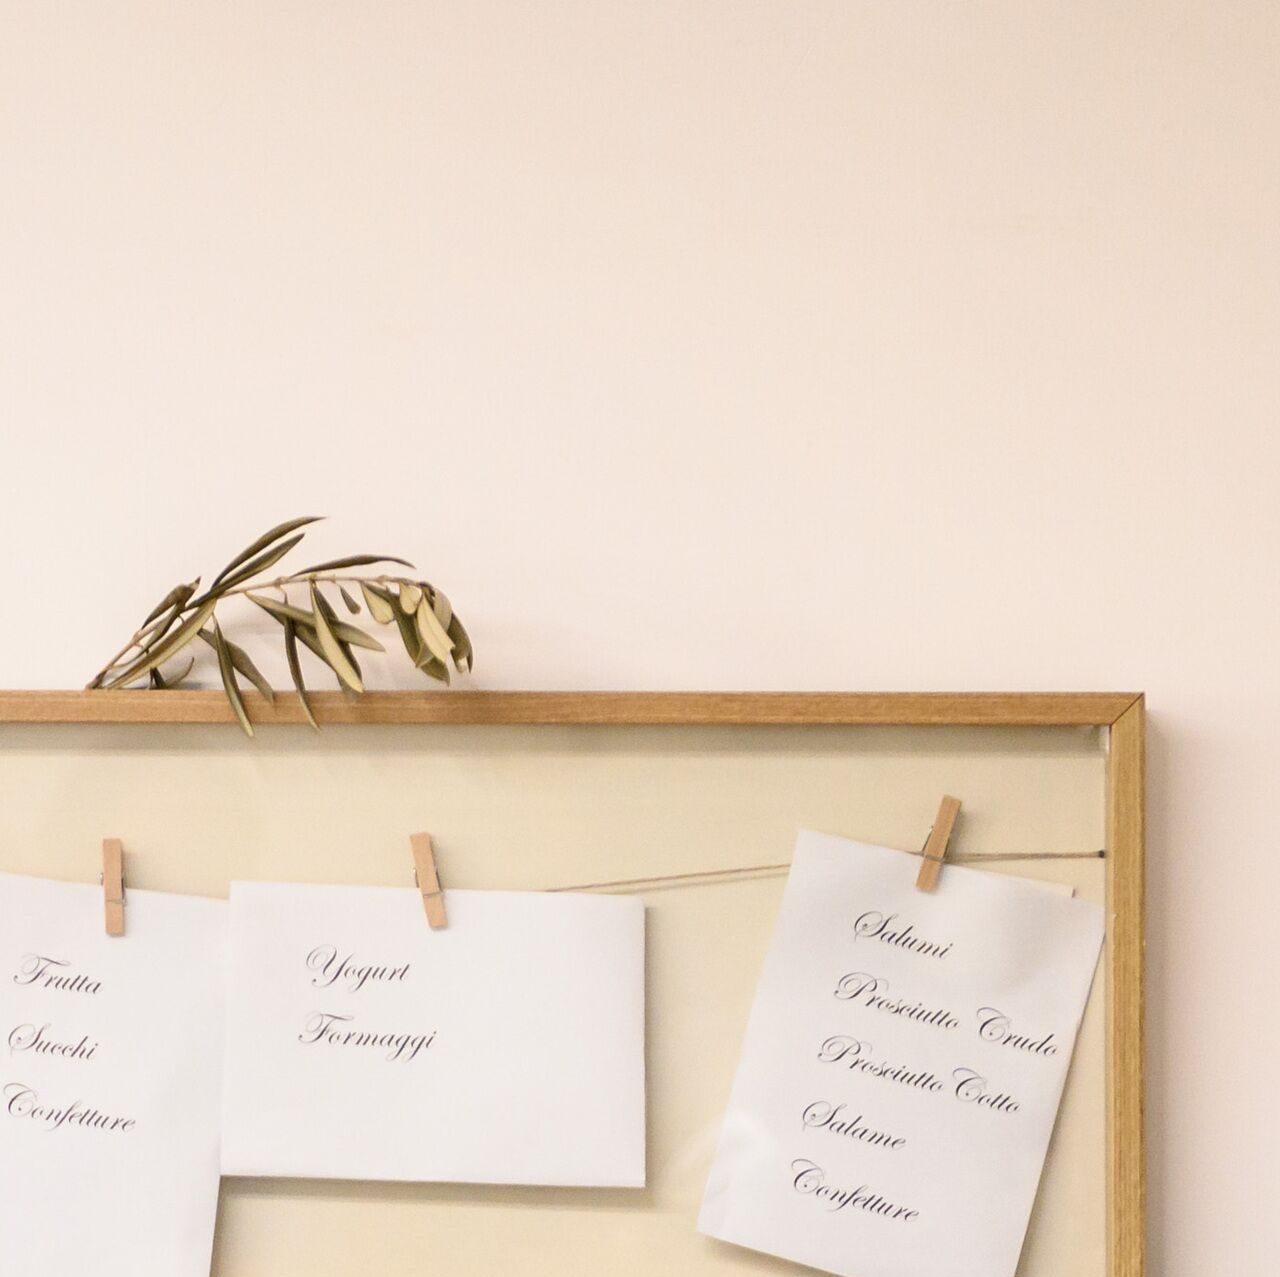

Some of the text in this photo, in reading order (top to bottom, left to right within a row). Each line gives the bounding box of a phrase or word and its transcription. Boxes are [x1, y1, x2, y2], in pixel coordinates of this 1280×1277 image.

[853, 910, 953, 960] Salumi
[12, 953, 103, 996] Frutta
[305, 943, 410, 992] Yogurt
[298, 1011, 437, 1062] Formaggi
[834, 972, 1059, 1058] Prosciutto Crudo
[8, 1022, 98, 1062] Succhi
[818, 1035, 1021, 1115] Prosciutto Cotto
[3, 1081, 137, 1133] Confetture
[802, 1100, 907, 1150] Salame
[791, 1158, 920, 1223] Confetture
